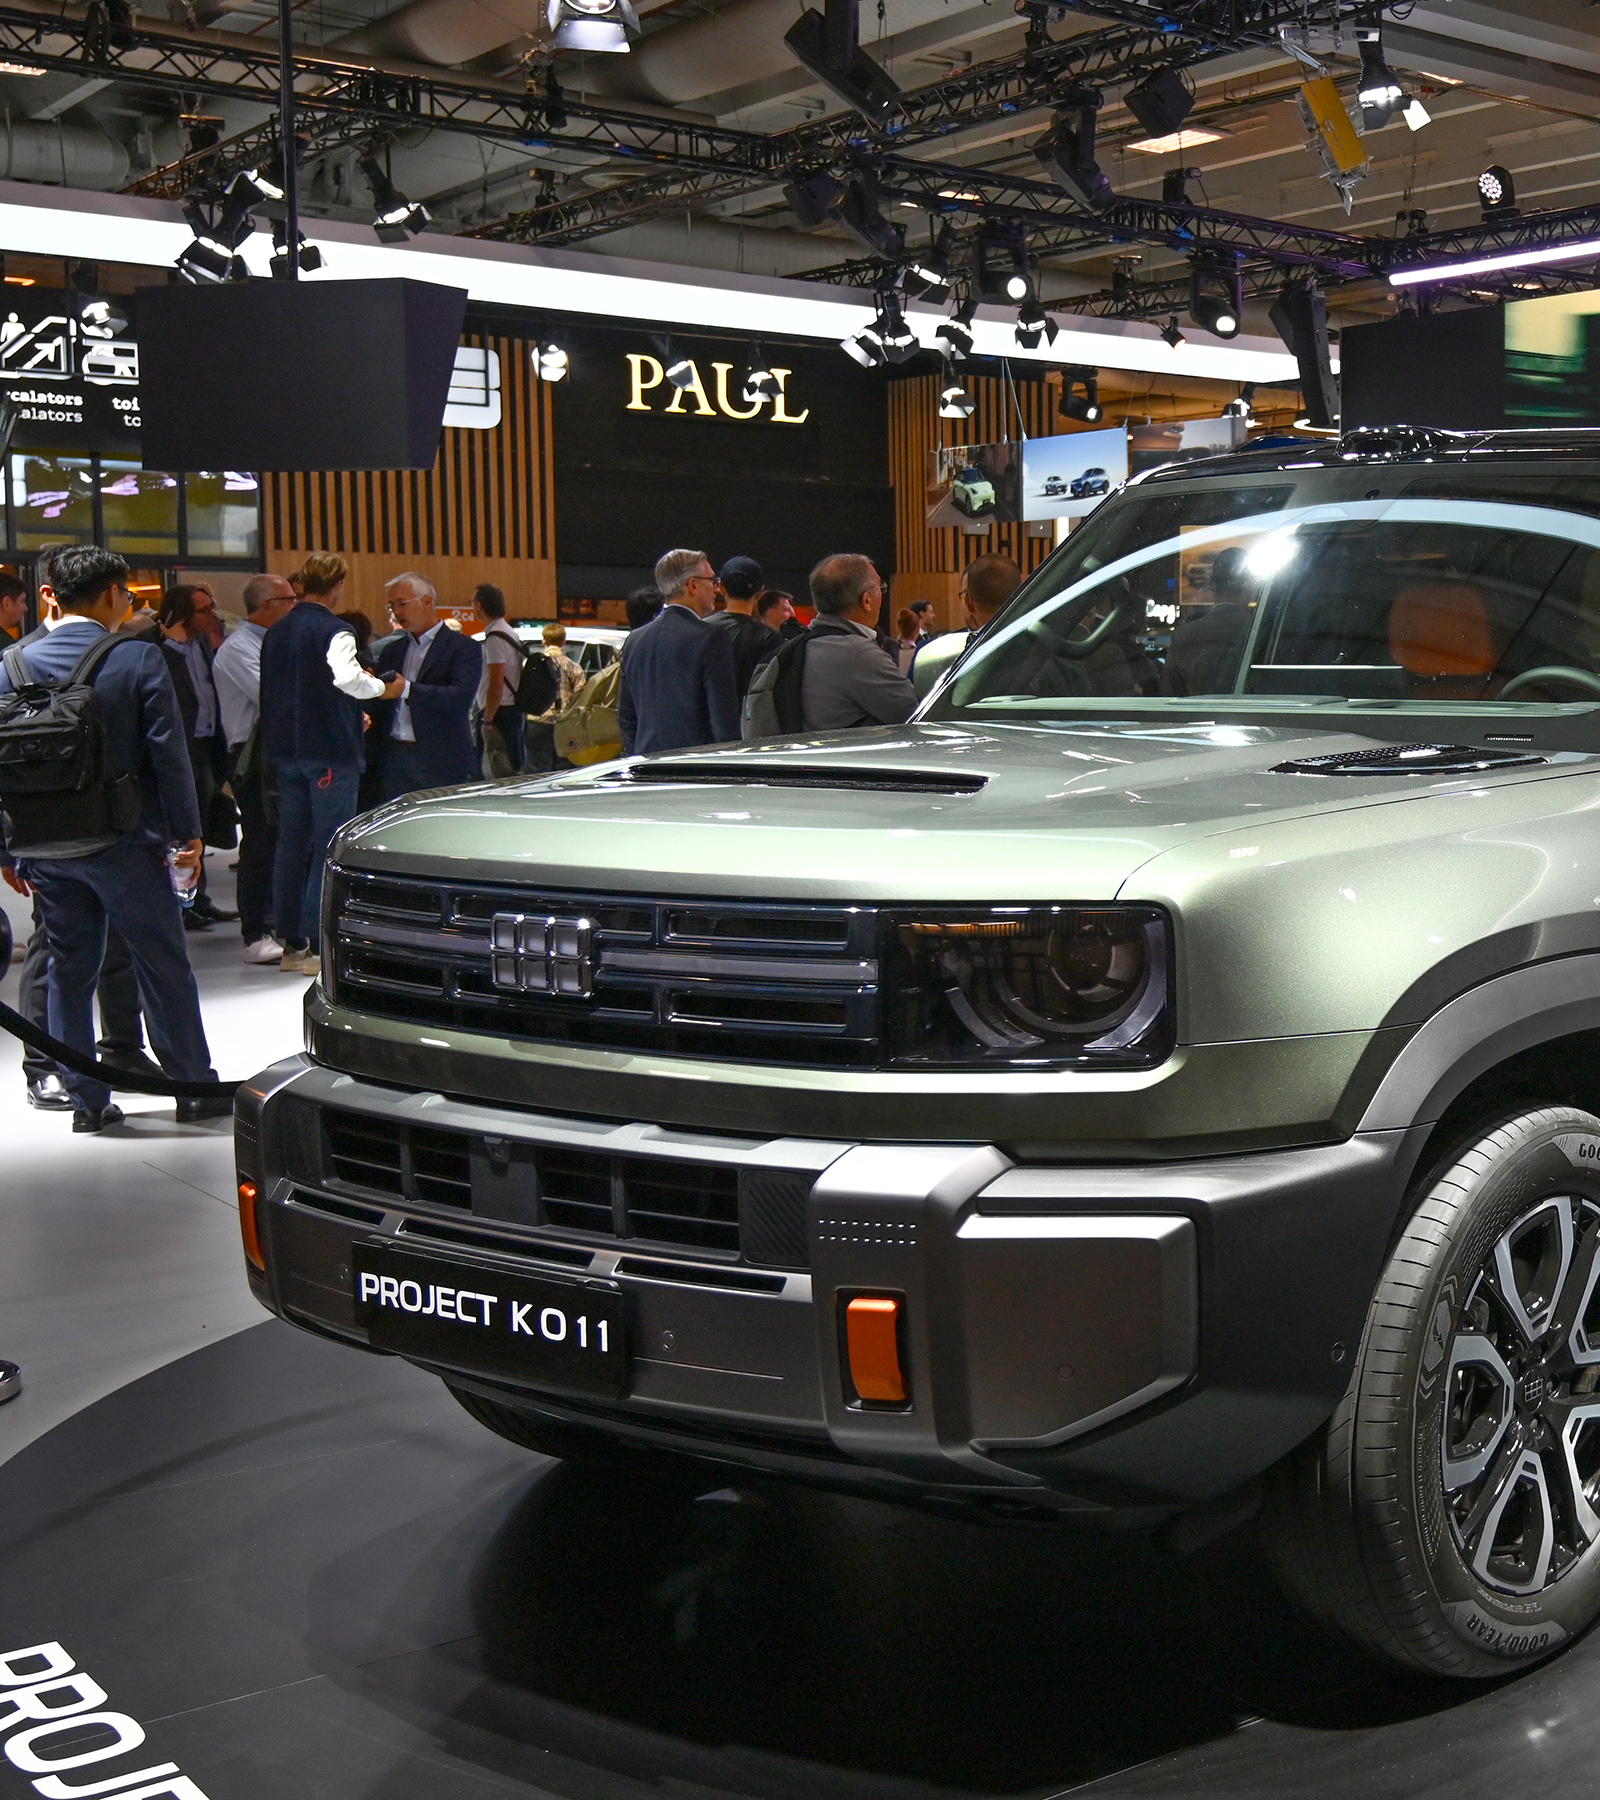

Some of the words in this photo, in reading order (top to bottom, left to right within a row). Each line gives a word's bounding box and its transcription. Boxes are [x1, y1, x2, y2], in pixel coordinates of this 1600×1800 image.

[7, 390, 84, 406] calators
[111, 396, 141, 411] toi
[625, 353, 810, 424] PAUL
[20, 407, 84, 423] alators
[360, 1271, 498, 1326] PROJECT
[1466, 1613, 1550, 1653] GOODYEAR
[0, 1640, 210, 1800] PROJ
